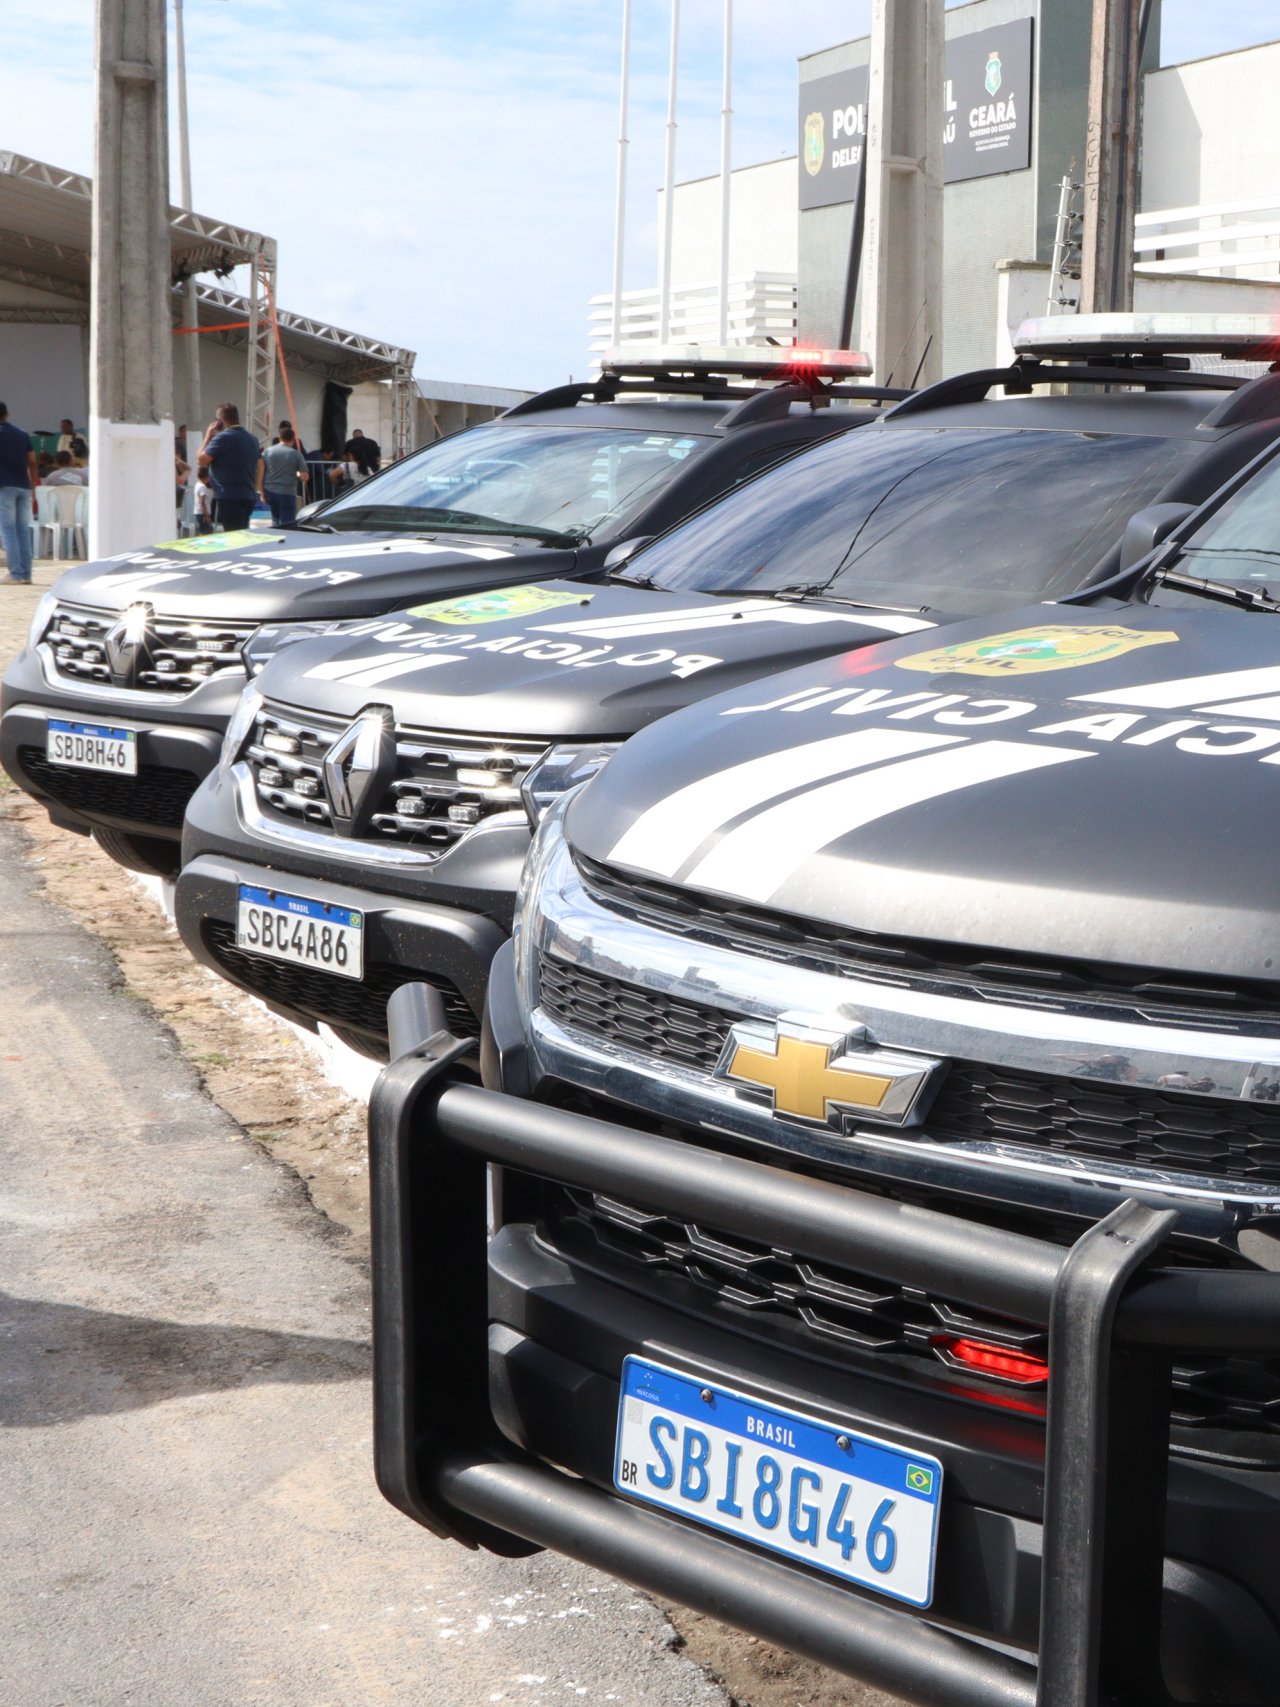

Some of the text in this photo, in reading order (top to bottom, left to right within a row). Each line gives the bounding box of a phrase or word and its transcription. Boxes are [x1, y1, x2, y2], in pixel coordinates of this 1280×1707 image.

[969, 92, 1017, 128] CEARÁ
[930, 655, 1019, 670] CIVIL
[55, 734, 126, 767] SBD8H46
[288, 902, 310, 914] BRASIL
[247, 908, 348, 967] SBC4A86
[746, 1415, 796, 1449] BRASIL
[621, 1459, 638, 1486] BR
[646, 1414, 897, 1574] SBI8G46
